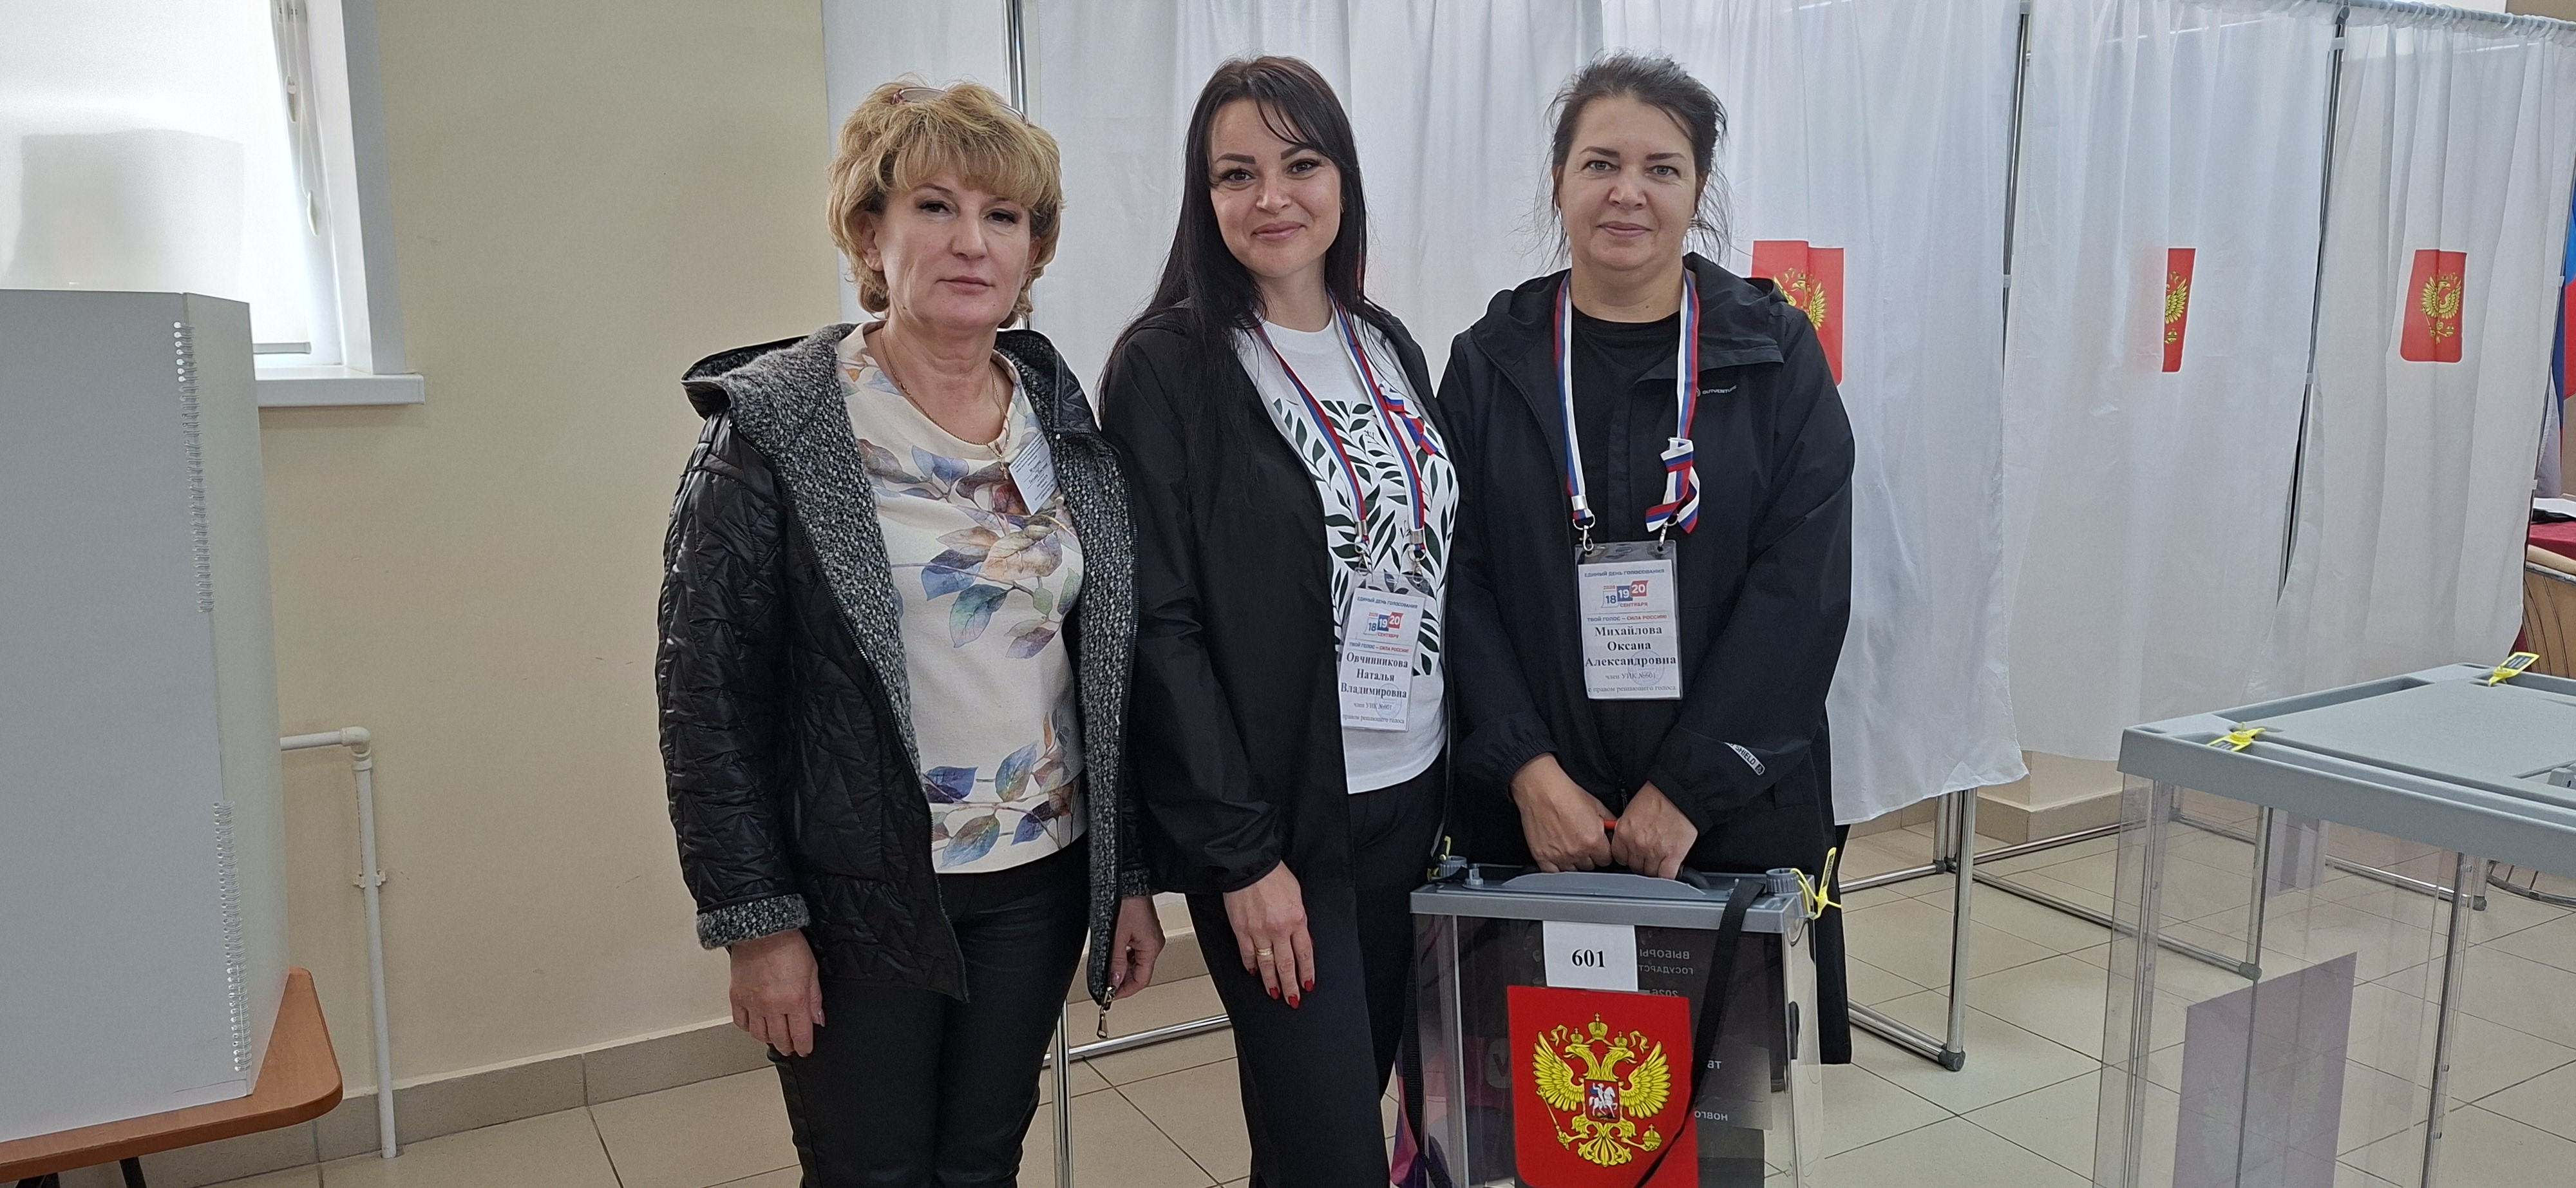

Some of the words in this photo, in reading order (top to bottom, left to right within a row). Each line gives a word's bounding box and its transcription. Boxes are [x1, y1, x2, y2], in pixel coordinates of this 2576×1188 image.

[1605, 595, 1616, 604] 18
[1618, 589, 1629, 599] 19
[1631, 584, 1645, 593] 20
[1368, 622, 1377, 631] 18
[1379, 618, 1388, 628] 19
[1389, 616, 1400, 625] 20
[1594, 625, 1662, 637] Михайлова
[1607, 641, 1651, 651] Оксана
[1346, 651, 1408, 668] Овчинникова
[1586, 656, 1676, 667] Александровна
[1356, 668, 1395, 682] Наталья
[1341, 682, 1407, 698] Владимировна
[1571, 949, 1605, 968] 601
